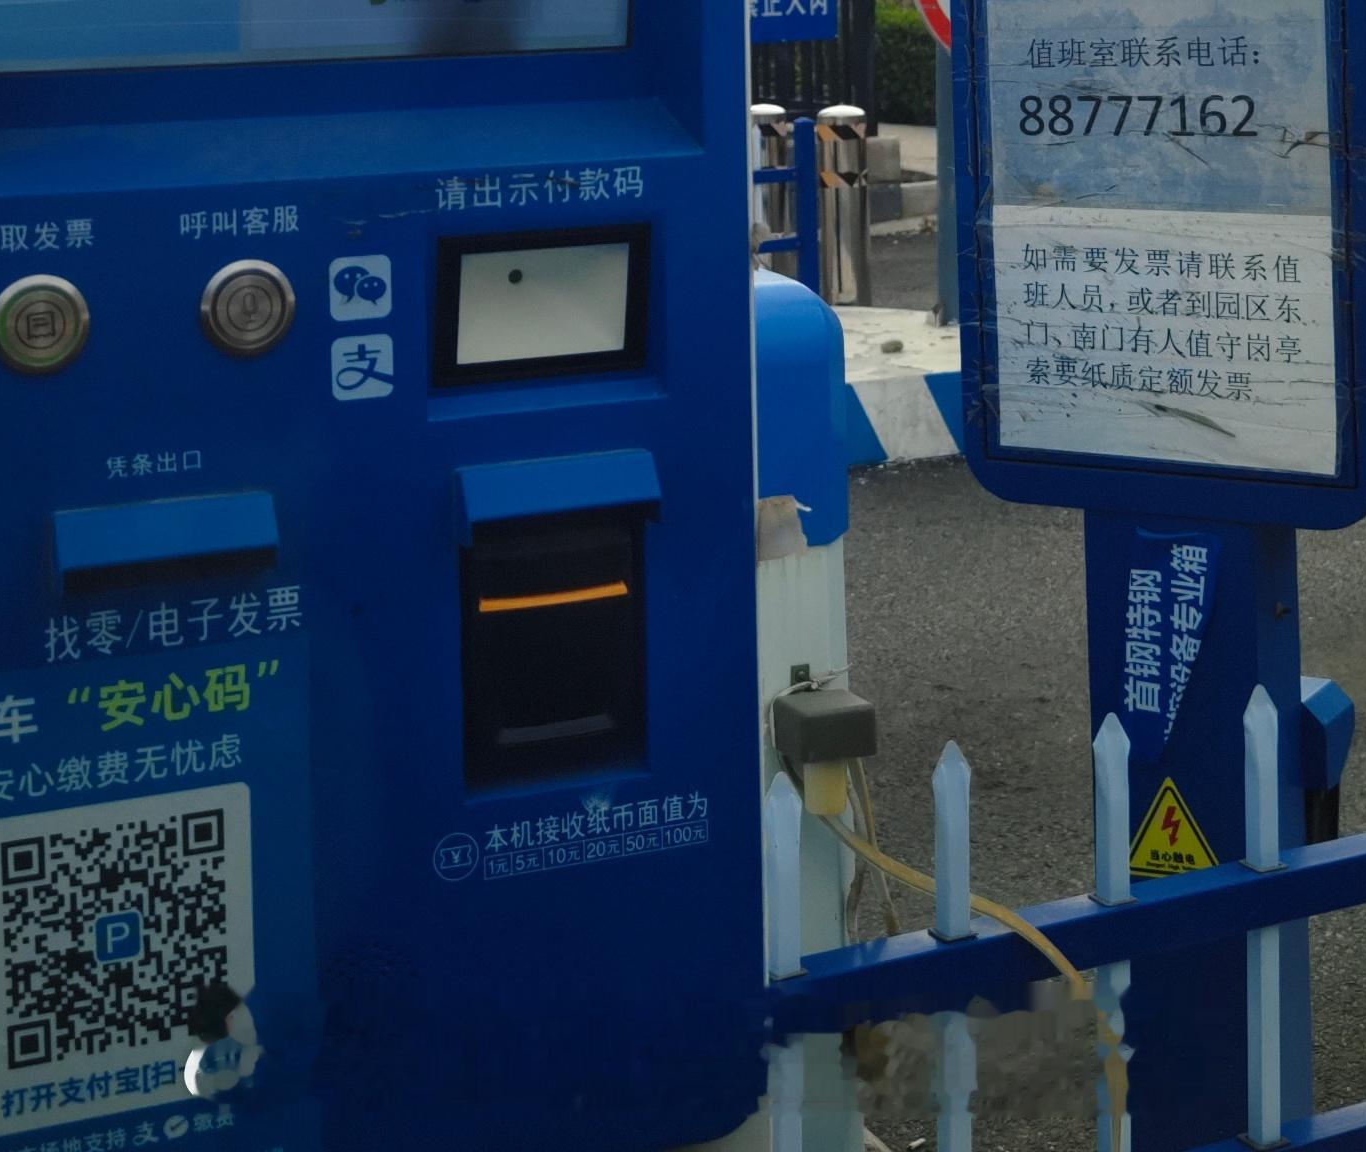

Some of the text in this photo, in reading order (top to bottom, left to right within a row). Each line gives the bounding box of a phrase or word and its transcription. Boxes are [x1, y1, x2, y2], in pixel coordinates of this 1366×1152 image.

[1027, 34, 1261, 69] 值班室联系电话：
[1019, 93, 1258, 139] 88777162
[435, 164, 645, 211] 请出示付款码
[179, 204, 300, 241] 呼叫客服
[1021, 243, 1302, 284] 如需要发票请联系值
[1022, 282, 1302, 324] 班人员，或者到园区东
[1026, 320, 1302, 363] 门、南门有人值守岗亭
[1025, 356, 1254, 401] 索要纸质定额发票
[106, 450, 204, 479] 凭条出口
[44, 585, 303, 663] 找零/电子发票
[1123, 569, 1162, 713] 首钢特钢
[1163, 544, 1208, 744] 设备专业箱
[67, 659, 281, 733] “安心码”
[484, 790, 709, 852] 本机接收纸币面值为
[488, 823, 708, 878] 1元 5元 10元 20元 50元 100元
[1, 1061, 184, 1118] 打开支付宝[扫
